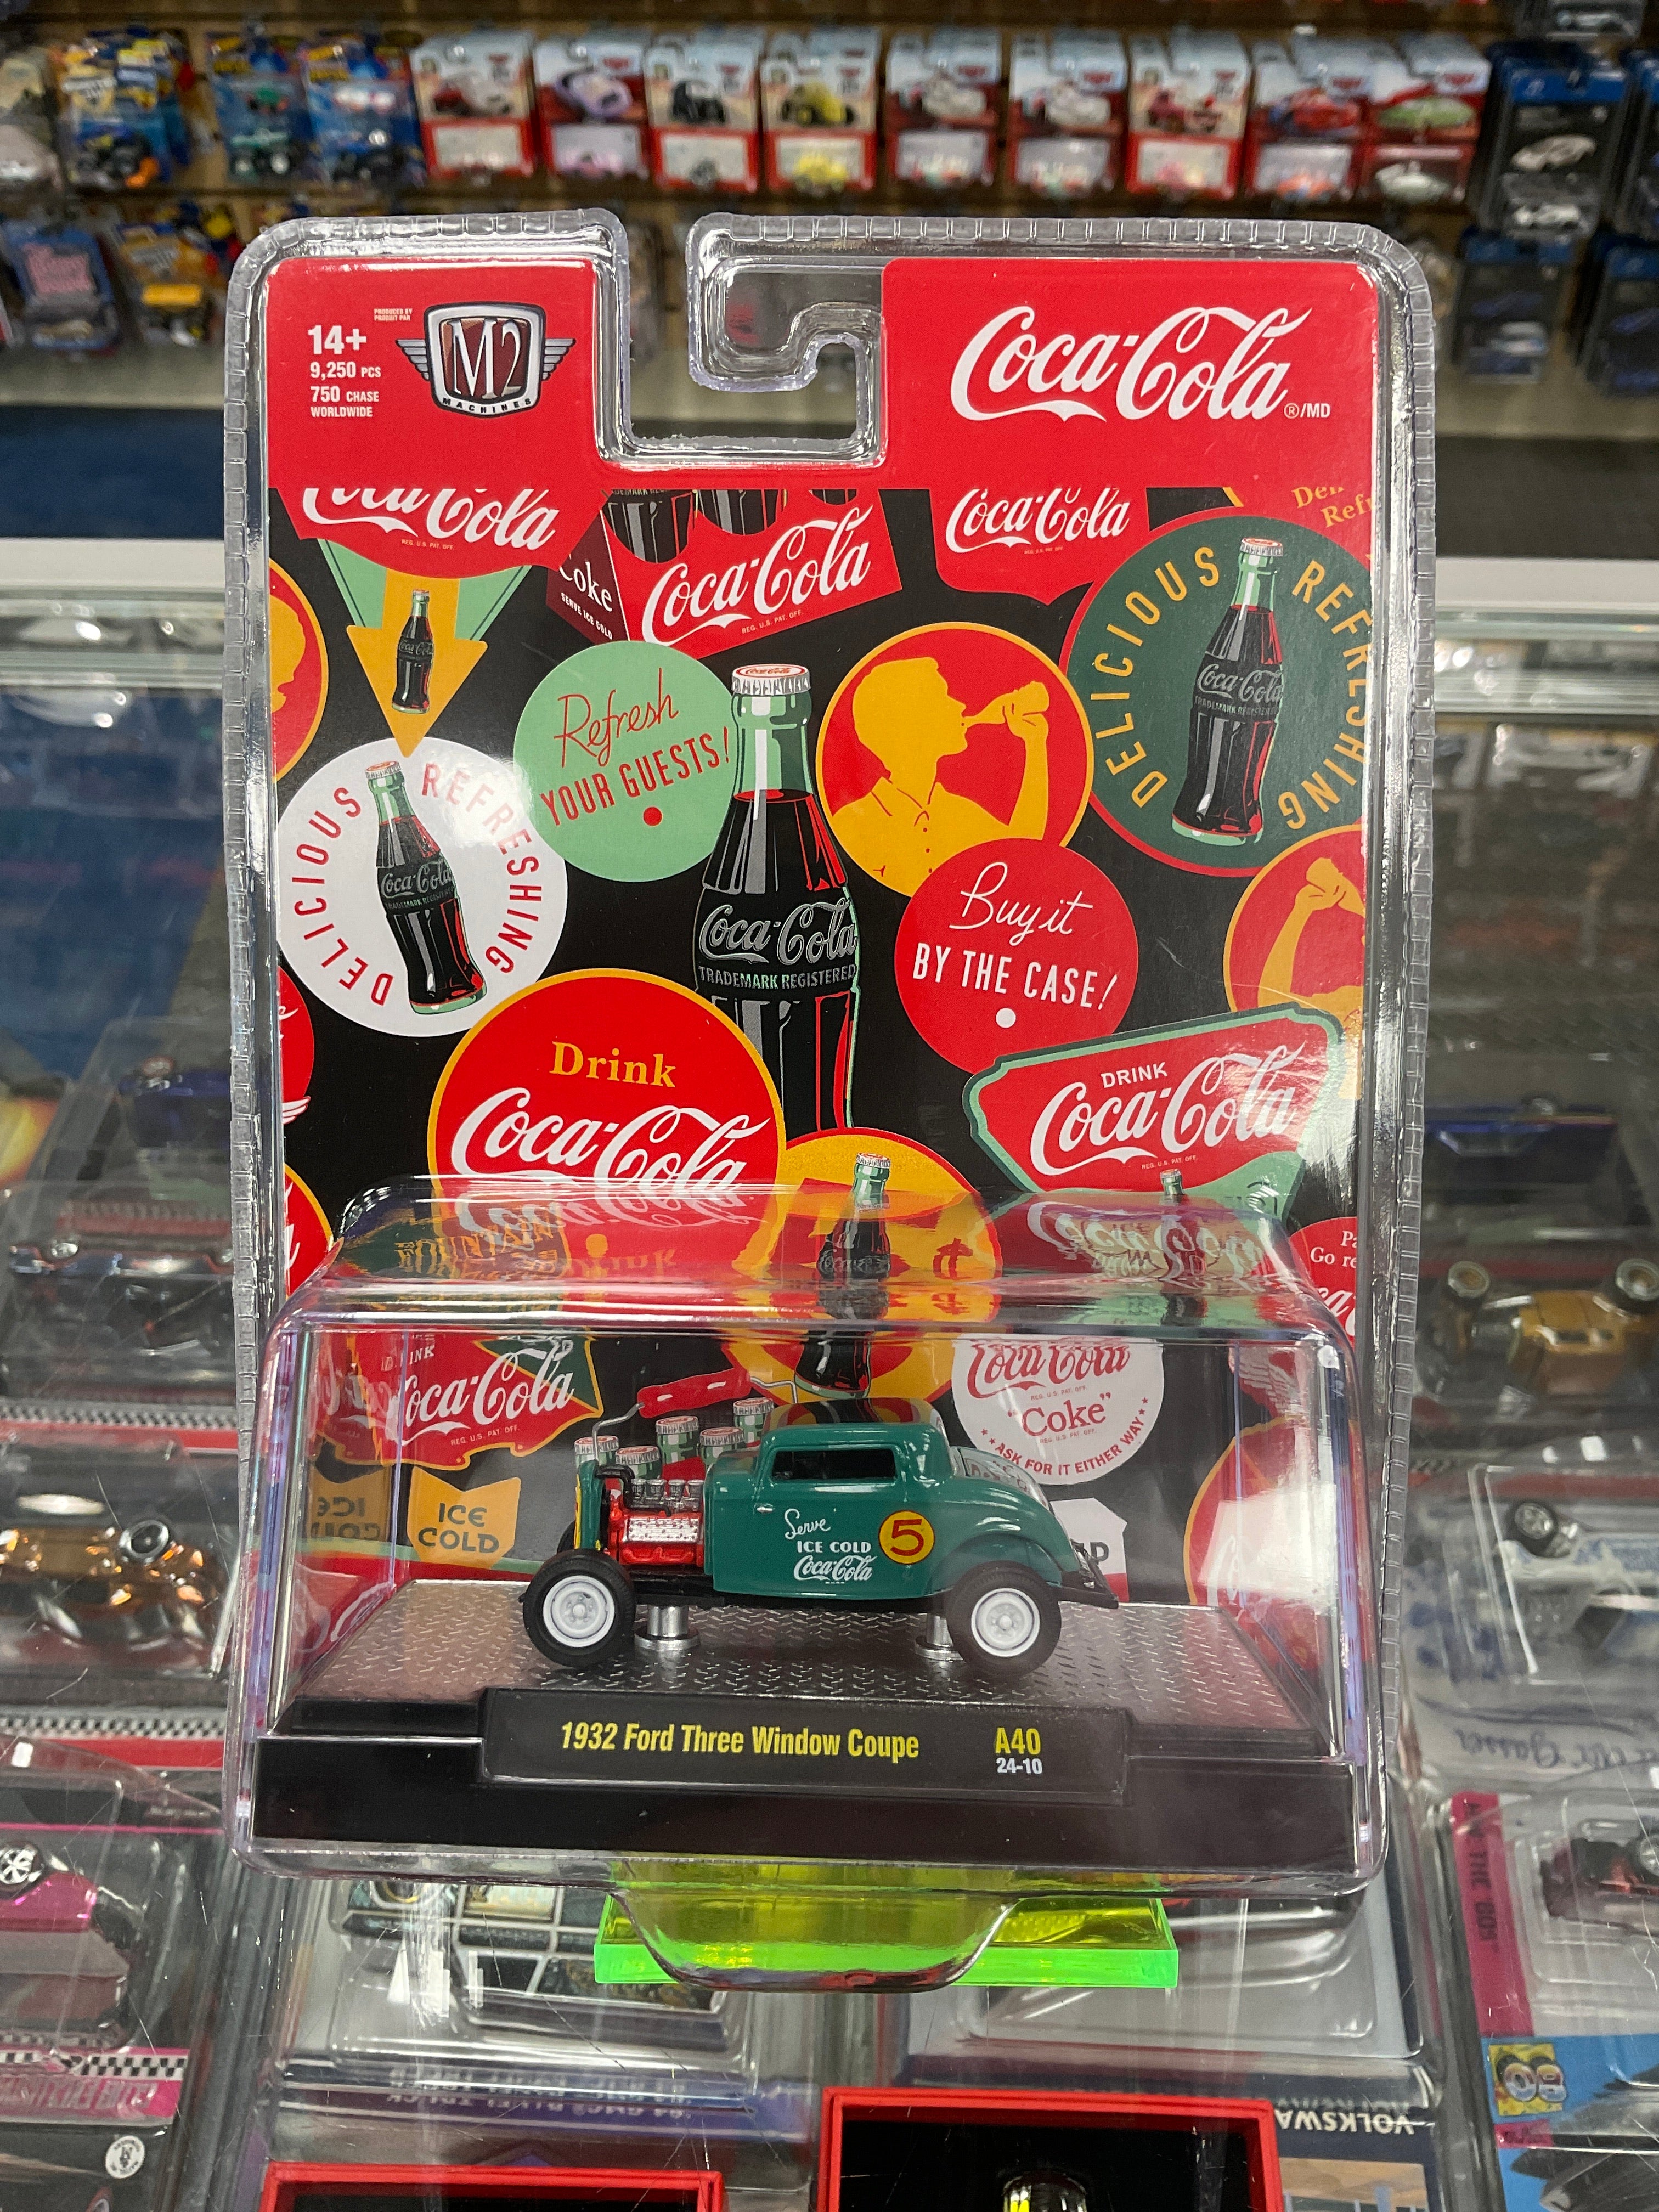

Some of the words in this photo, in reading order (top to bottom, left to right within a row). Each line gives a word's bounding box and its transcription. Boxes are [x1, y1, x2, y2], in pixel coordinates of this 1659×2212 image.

[308, 325, 367, 355] 14+
[452, 317, 523, 399] M2
[310, 362, 357, 381] 9,250
[360, 366, 382, 378] PCS
[950, 305, 1313, 422] Coca-Cola
[310, 386, 341, 403] 750
[346, 391, 380, 403] CHASE
[311, 406, 373, 418] WORLDWIDE
[442, 396, 532, 415] MACHINES
[642, 504, 873, 647] Coca-Cola
[561, 592, 582, 616] SERVE
[583, 610, 595, 626] ICE
[595, 620, 613, 640] COLD
[741, 625, 758, 635] REG.
[759, 619, 772, 630] U.S.
[774, 614, 788, 625] PAT.
[1090, 547, 1220, 808] DELICIOUS
[1197, 663, 1284, 703] Coca-Cola
[554, 668, 679, 768] Refresh
[540, 772, 616, 827] YOUR
[618, 726, 730, 799] GUESTS!
[380, 858, 452, 899] Coca-Cola
[421, 763, 544, 974] REFRESHING
[291, 787, 396, 1007] DELICIOUS
[949, 861, 1042, 947] Buy
[1040, 890, 1093, 936] it
[699, 896, 857, 965] Coca-Cola
[698, 965, 779, 990] TRADEMARK
[781, 964, 856, 989] REGISTERED
[912, 943, 950, 983] BY
[961, 949, 1012, 995] THE
[1025, 960, 1118, 1011] CASE!
[549, 1041, 676, 1088] Drink
[1101, 1060, 1169, 1089] DRINK
[1029, 1040, 1308, 1177] Coca-Cola
[451, 1087, 771, 1196] Coca-Cola
[1310, 1246, 1335, 1265] Go
[995, 1442, 1022, 1466] ASK
[1024, 1458, 1052, 1476] FOR
[1058, 1464, 1071, 1476] IT
[1075, 1443, 1123, 1474] EITHER
[1119, 1418, 1146, 1446] WAY
[438, 1502, 488, 1528] ICE
[785, 1508, 831, 1539] Serve
[417, 1528, 500, 1554] COLD
[797, 1541, 823, 1553] ICE
[829, 1541, 872, 1554] COLD
[890, 1519, 924, 1557] 5
[793, 1555, 877, 1582] Coca-Cola
[561, 1721, 616, 1751] 1932
[623, 1723, 675, 1752] Ford
[681, 1724, 744, 1754] Three
[751, 1726, 840, 1757] Window
[848, 1729, 919, 1764] Coupe
[995, 1728, 1041, 1756] A40
[996, 1757, 1043, 1776] 24-10
[1273, 2109, 1415, 2135] VOLKSWA
